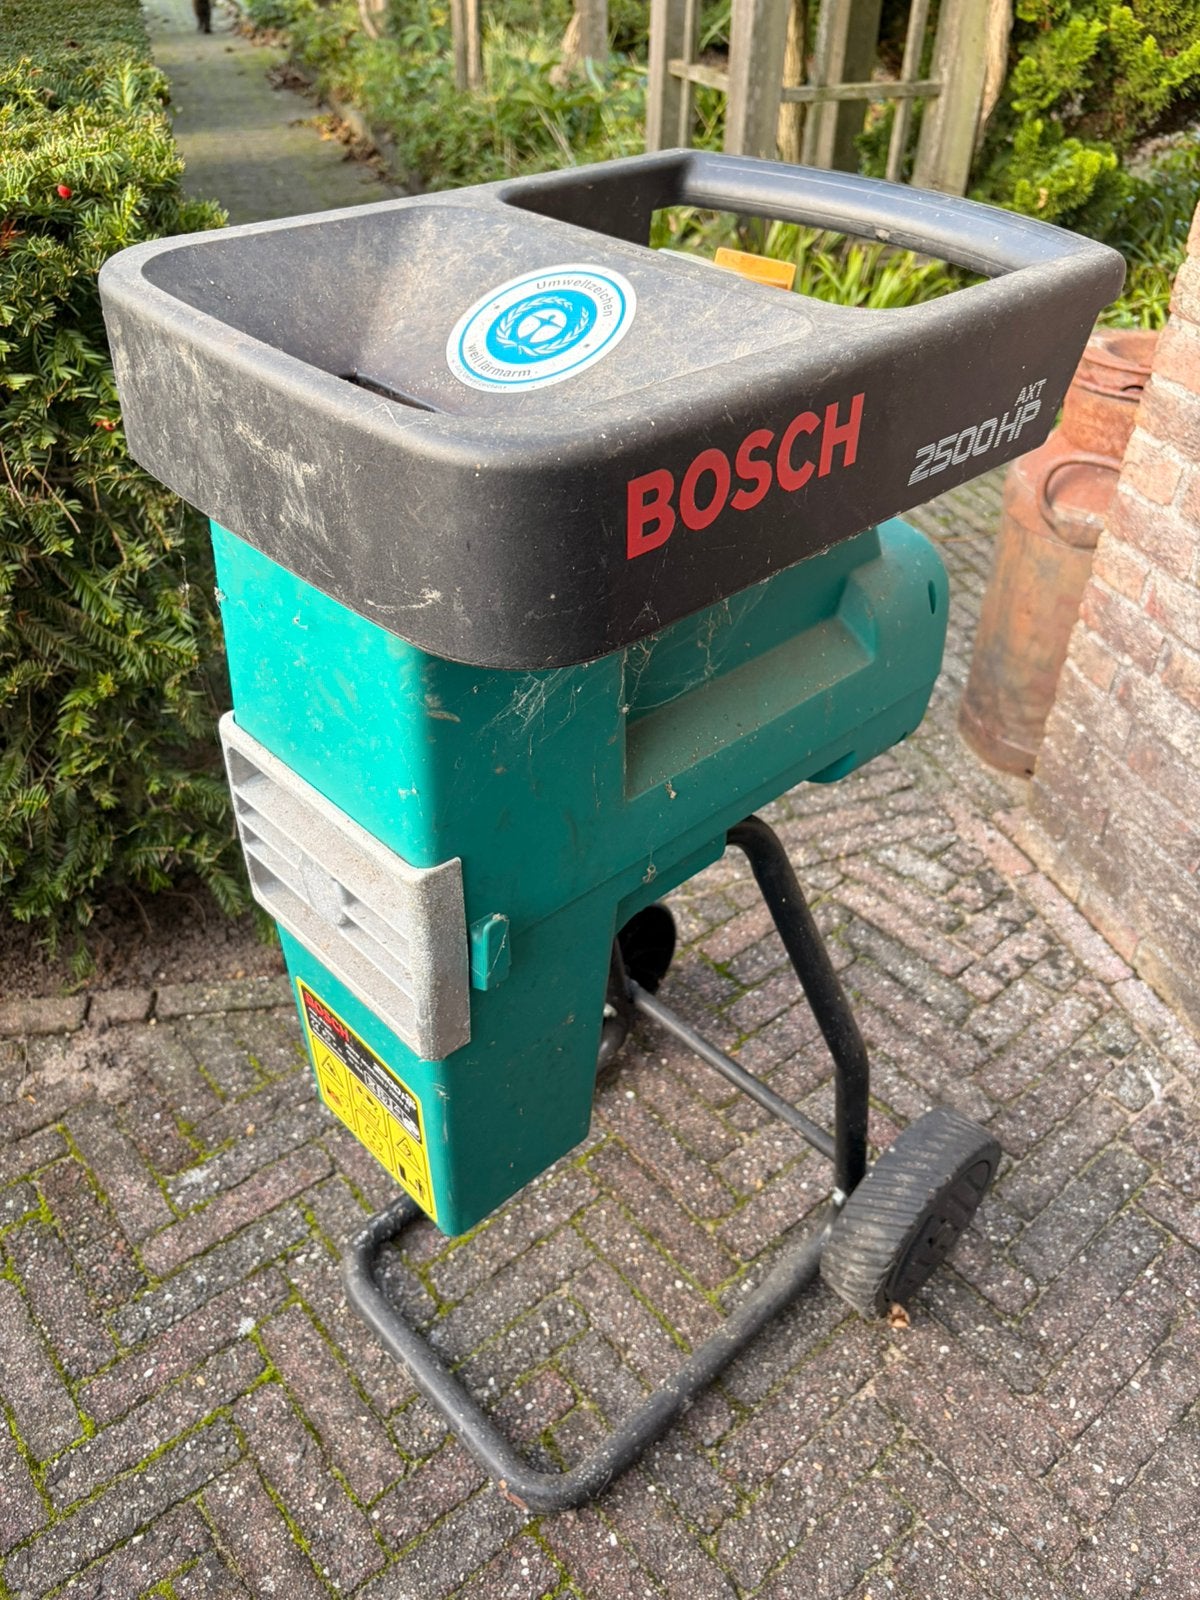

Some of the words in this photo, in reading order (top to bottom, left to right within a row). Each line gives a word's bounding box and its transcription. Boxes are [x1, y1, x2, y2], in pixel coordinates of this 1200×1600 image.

[536, 279, 613, 317] Umweltzeichen
[468, 343, 485, 364] weil
[478, 360, 531, 378] lärmarm
[1014, 378, 1047, 407] AXT
[627, 393, 865, 559] BOSCH
